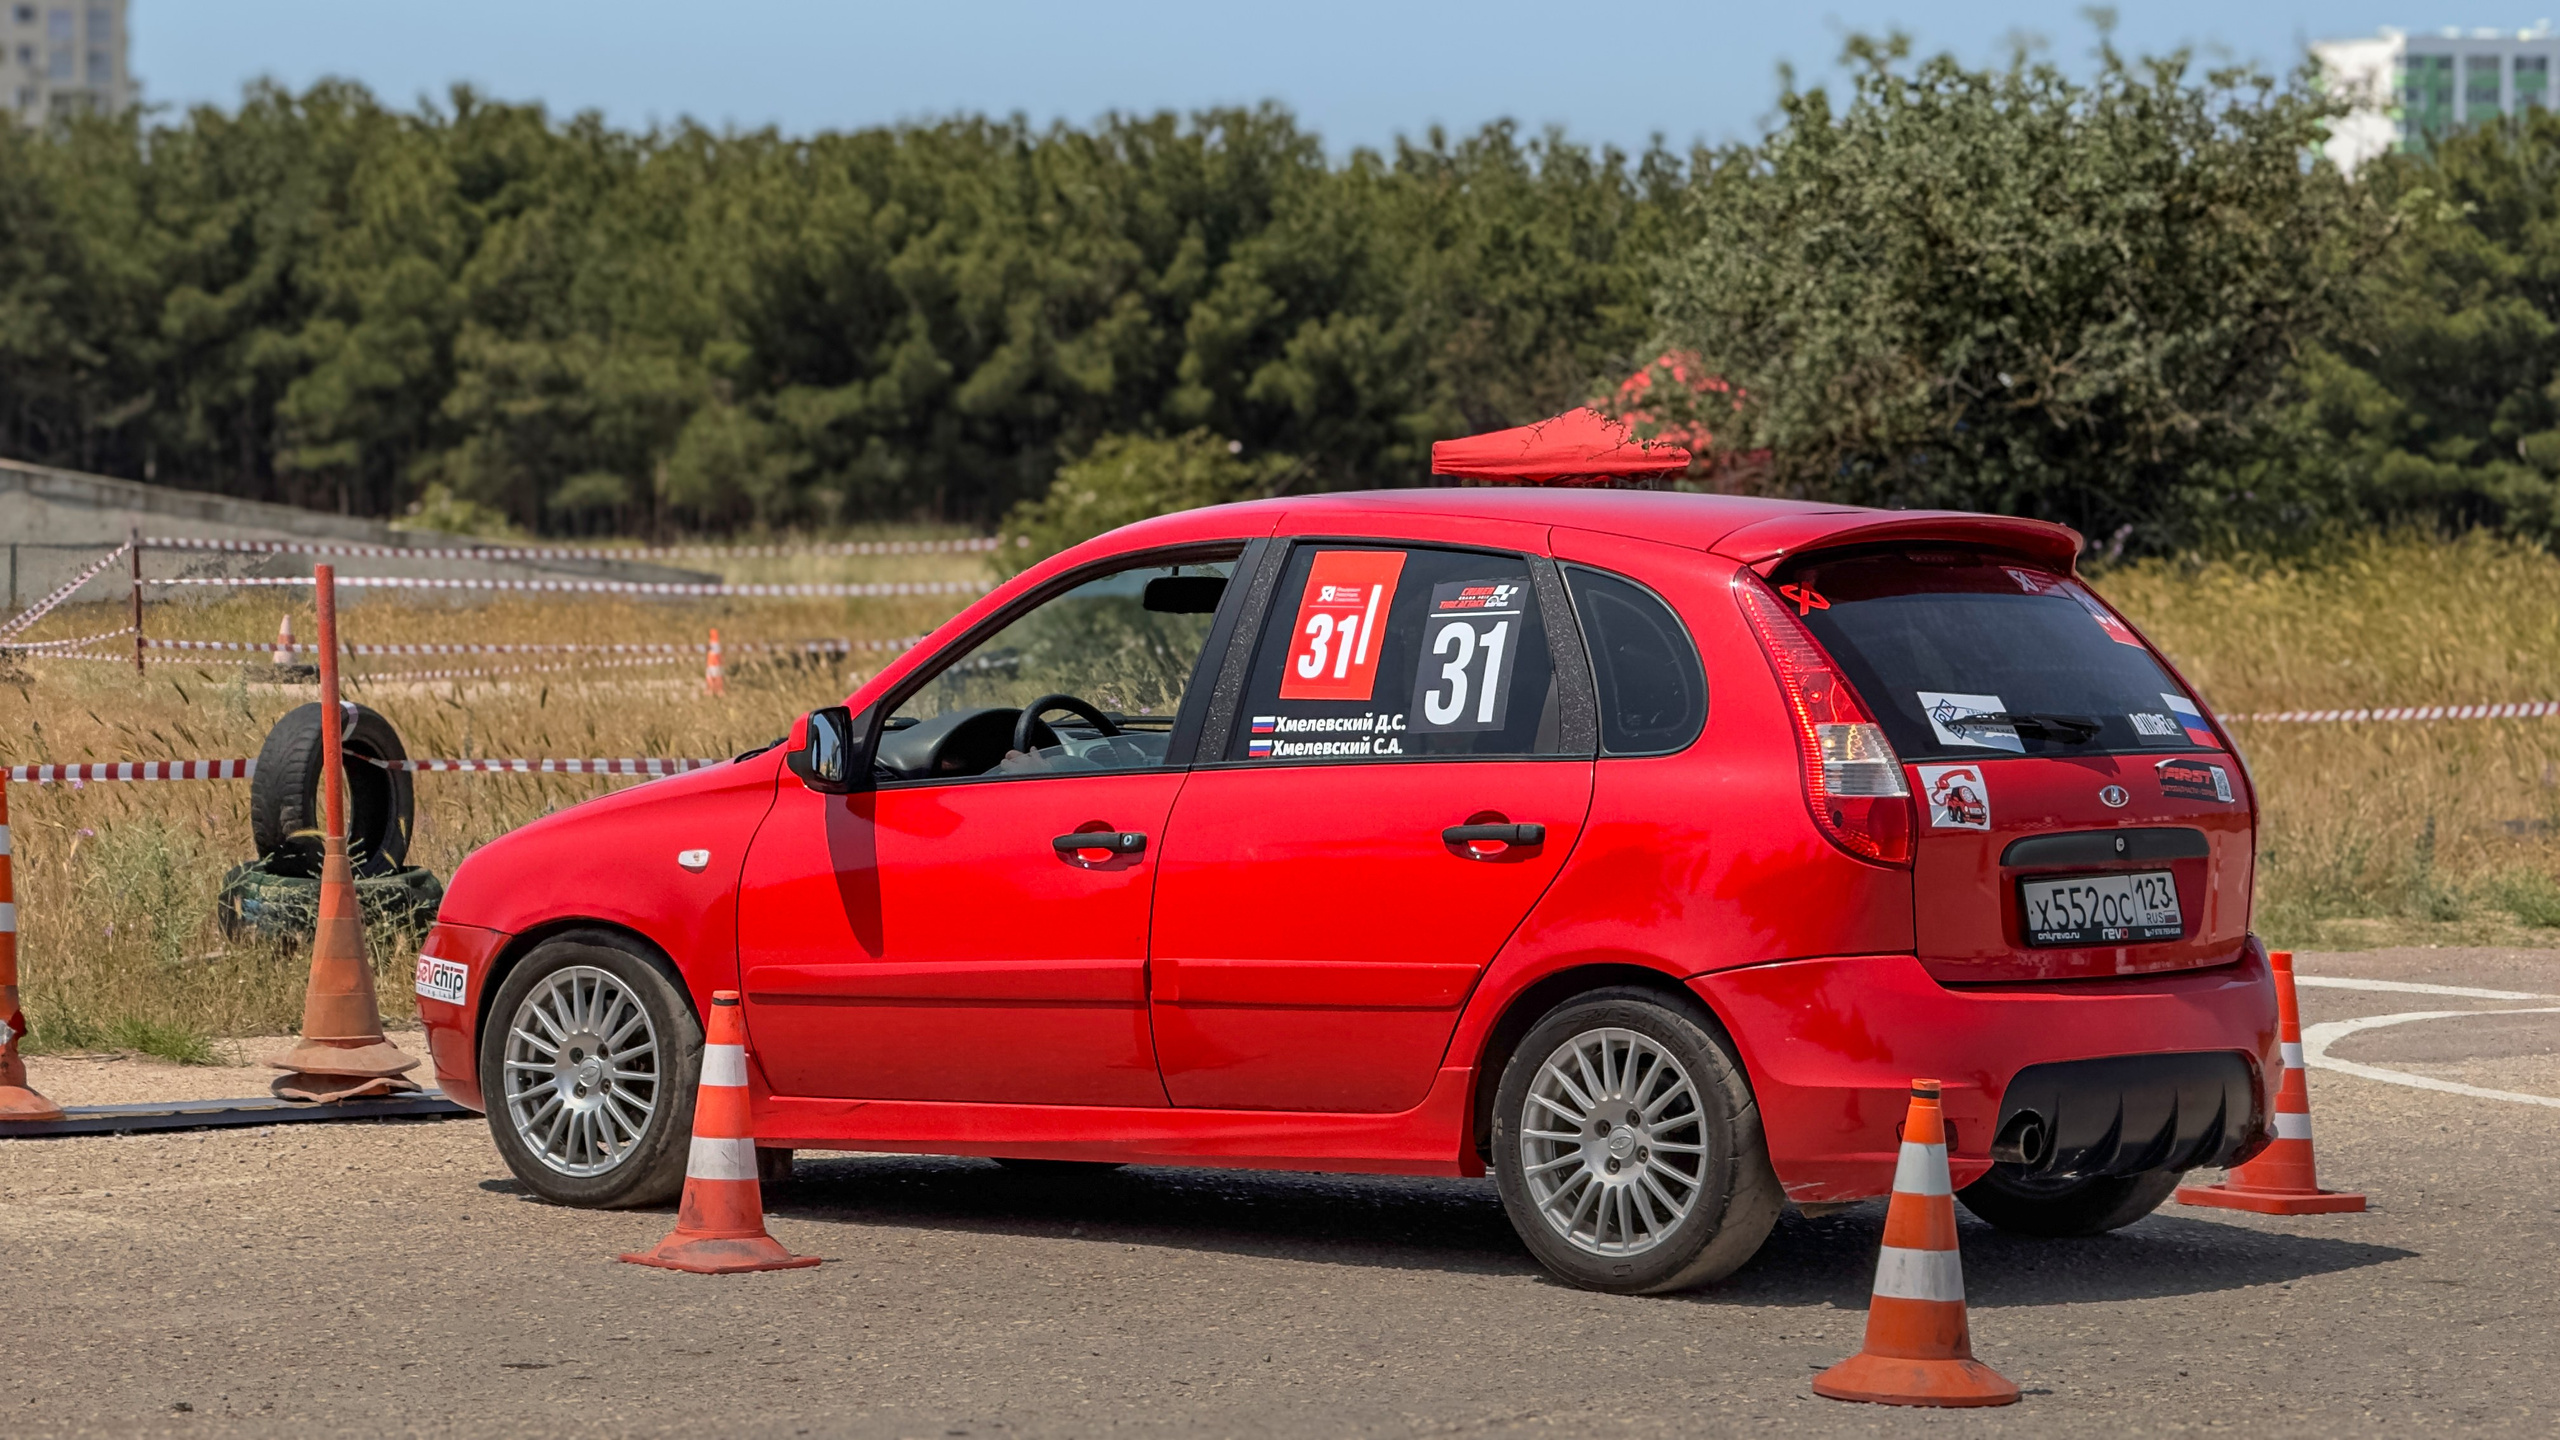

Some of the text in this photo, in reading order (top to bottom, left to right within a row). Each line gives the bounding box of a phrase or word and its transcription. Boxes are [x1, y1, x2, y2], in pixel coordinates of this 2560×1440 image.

[1297, 613, 1359, 679] 31
[1424, 621, 1509, 725] 31
[1274, 712, 1407, 734] Хмелевский Д.С.
[1271, 736, 1404, 756] Хмелевский С.А.
[2160, 766, 2212, 784] FIRST
[2135, 877, 2171, 911] 123
[2146, 911, 2165, 924] RUS
[2037, 928, 2129, 941] onlyrevo.ru revo
